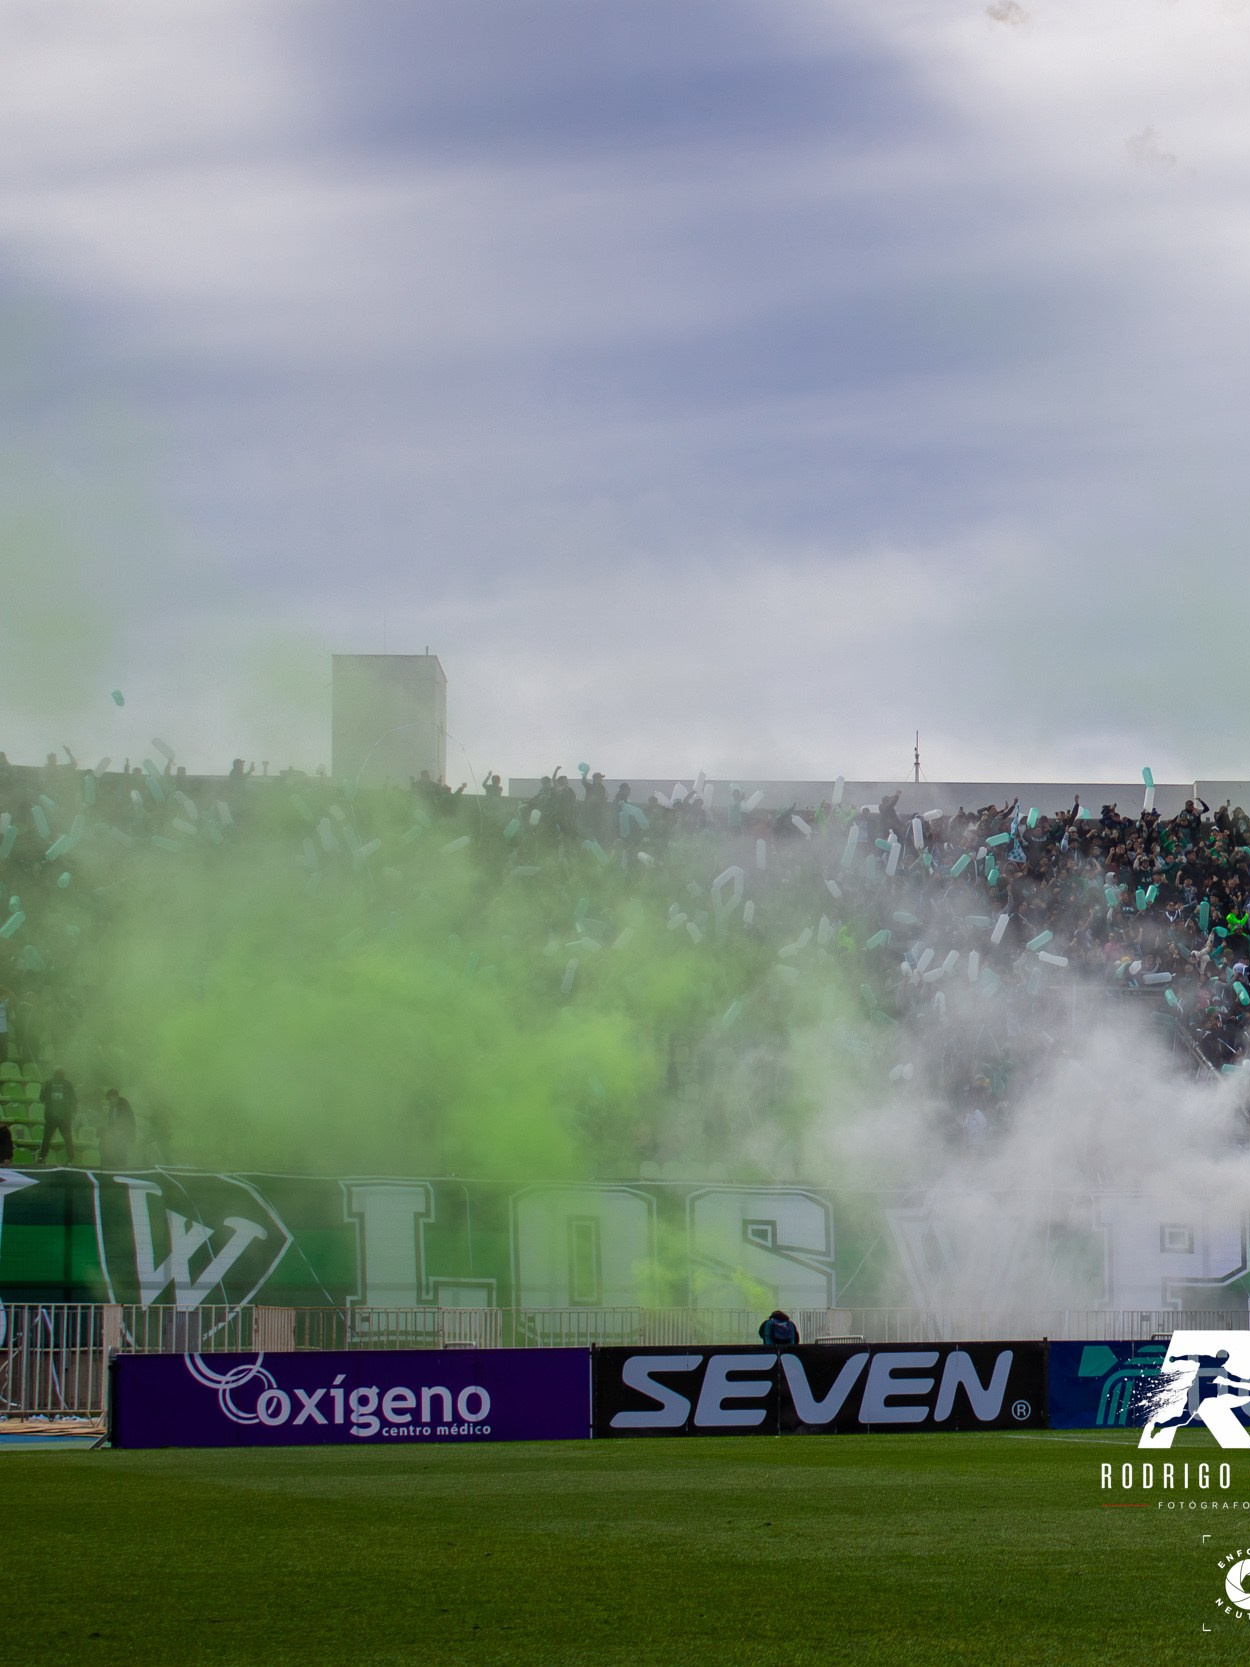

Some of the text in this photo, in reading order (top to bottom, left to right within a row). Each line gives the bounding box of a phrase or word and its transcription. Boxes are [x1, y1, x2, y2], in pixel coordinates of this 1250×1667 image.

[340, 1180, 836, 1338] LOS
[256, 1374, 490, 1437] oxígeno
[610, 1350, 1013, 1427] SEVEN
[382, 1422, 491, 1436] centro médico
